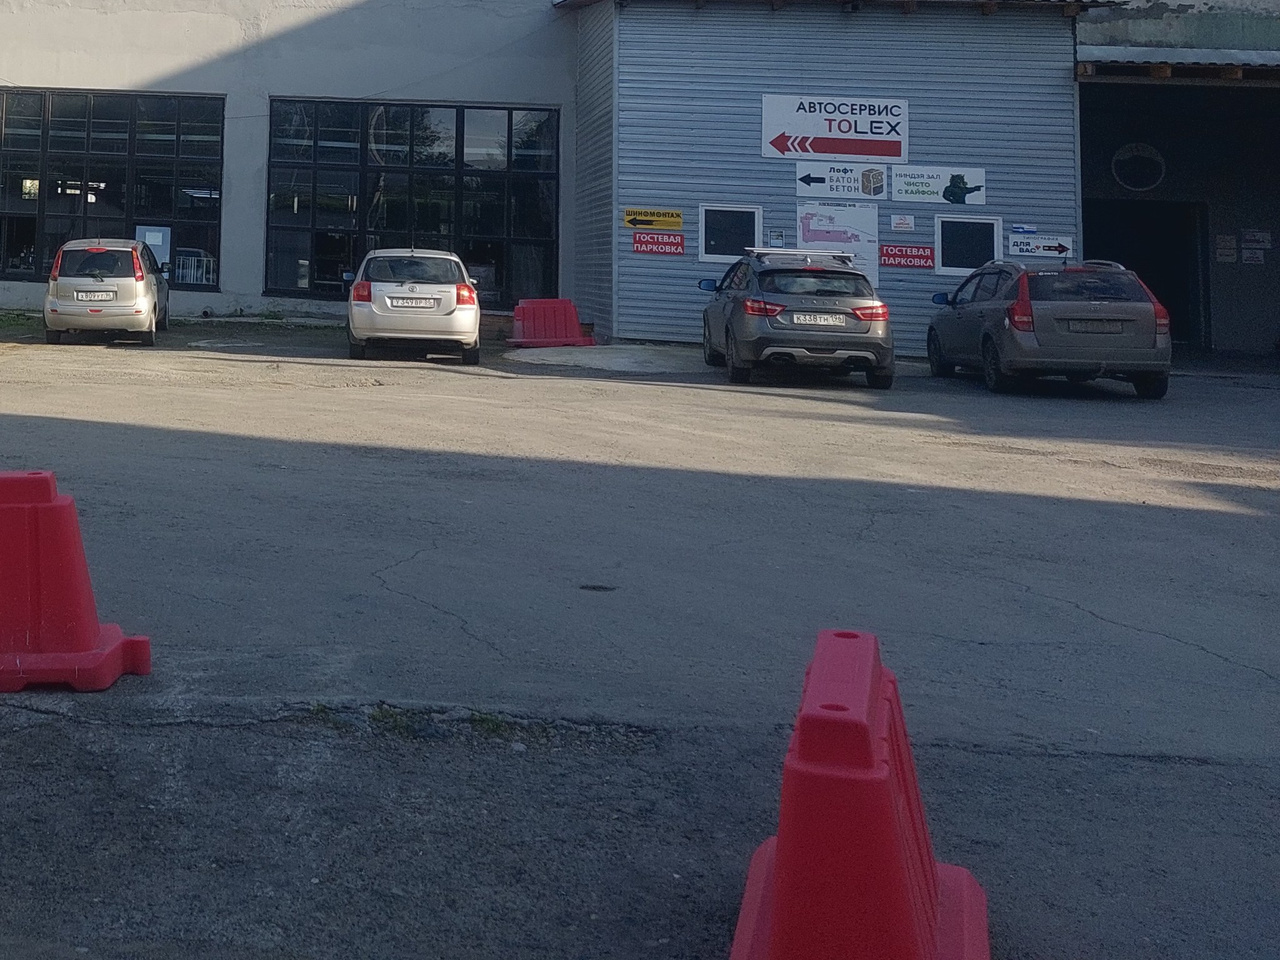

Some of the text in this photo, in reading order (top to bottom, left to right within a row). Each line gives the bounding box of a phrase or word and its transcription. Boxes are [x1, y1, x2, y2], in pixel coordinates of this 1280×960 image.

[795, 100, 902, 117] АВТОСЕРВИС
[823, 118, 902, 136] TOLEX
[828, 167, 854, 175] Лофт
[829, 176, 859, 185] БАТОН
[895, 172, 925, 180] НИНДЗЯ
[829, 185, 860, 193] БЕТОН
[904, 188, 940, 197] КАЙФОМ
[625, 210, 682, 219] ШИНОМОНТАЖ
[636, 234, 681, 243] ГОСТЕВАЯ
[634, 244, 684, 253] ПАРКОВКА
[1012, 240, 1031, 248] ДЛЯ
[883, 246, 931, 256] ГОСТЕВАЯ
[881, 256, 934, 267] ПАРКОВКА
